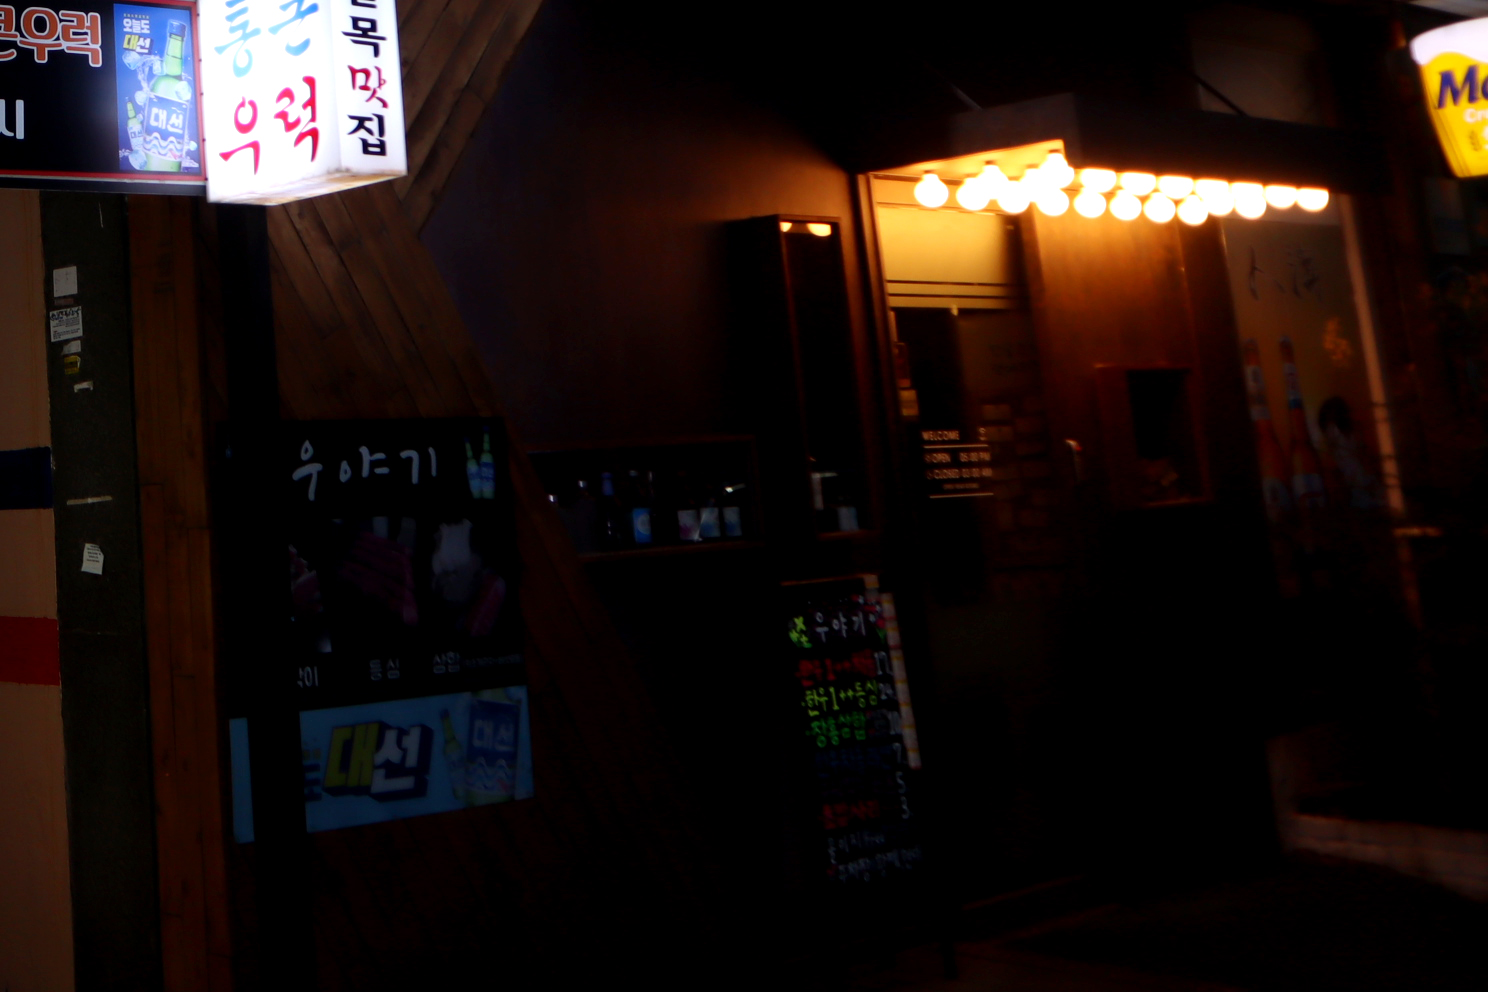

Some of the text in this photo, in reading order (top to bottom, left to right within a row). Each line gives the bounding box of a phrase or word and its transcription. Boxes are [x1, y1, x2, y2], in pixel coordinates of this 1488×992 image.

[123, 18, 150, 34] 오늘도
[123, 34, 152, 53] 대선
[149, 107, 184, 134] 대선
[219, 75, 320, 175] 우럭
[291, 438, 438, 502] 우야기
[472, 717, 516, 753] 대선
[323, 721, 431, 799] 대선
